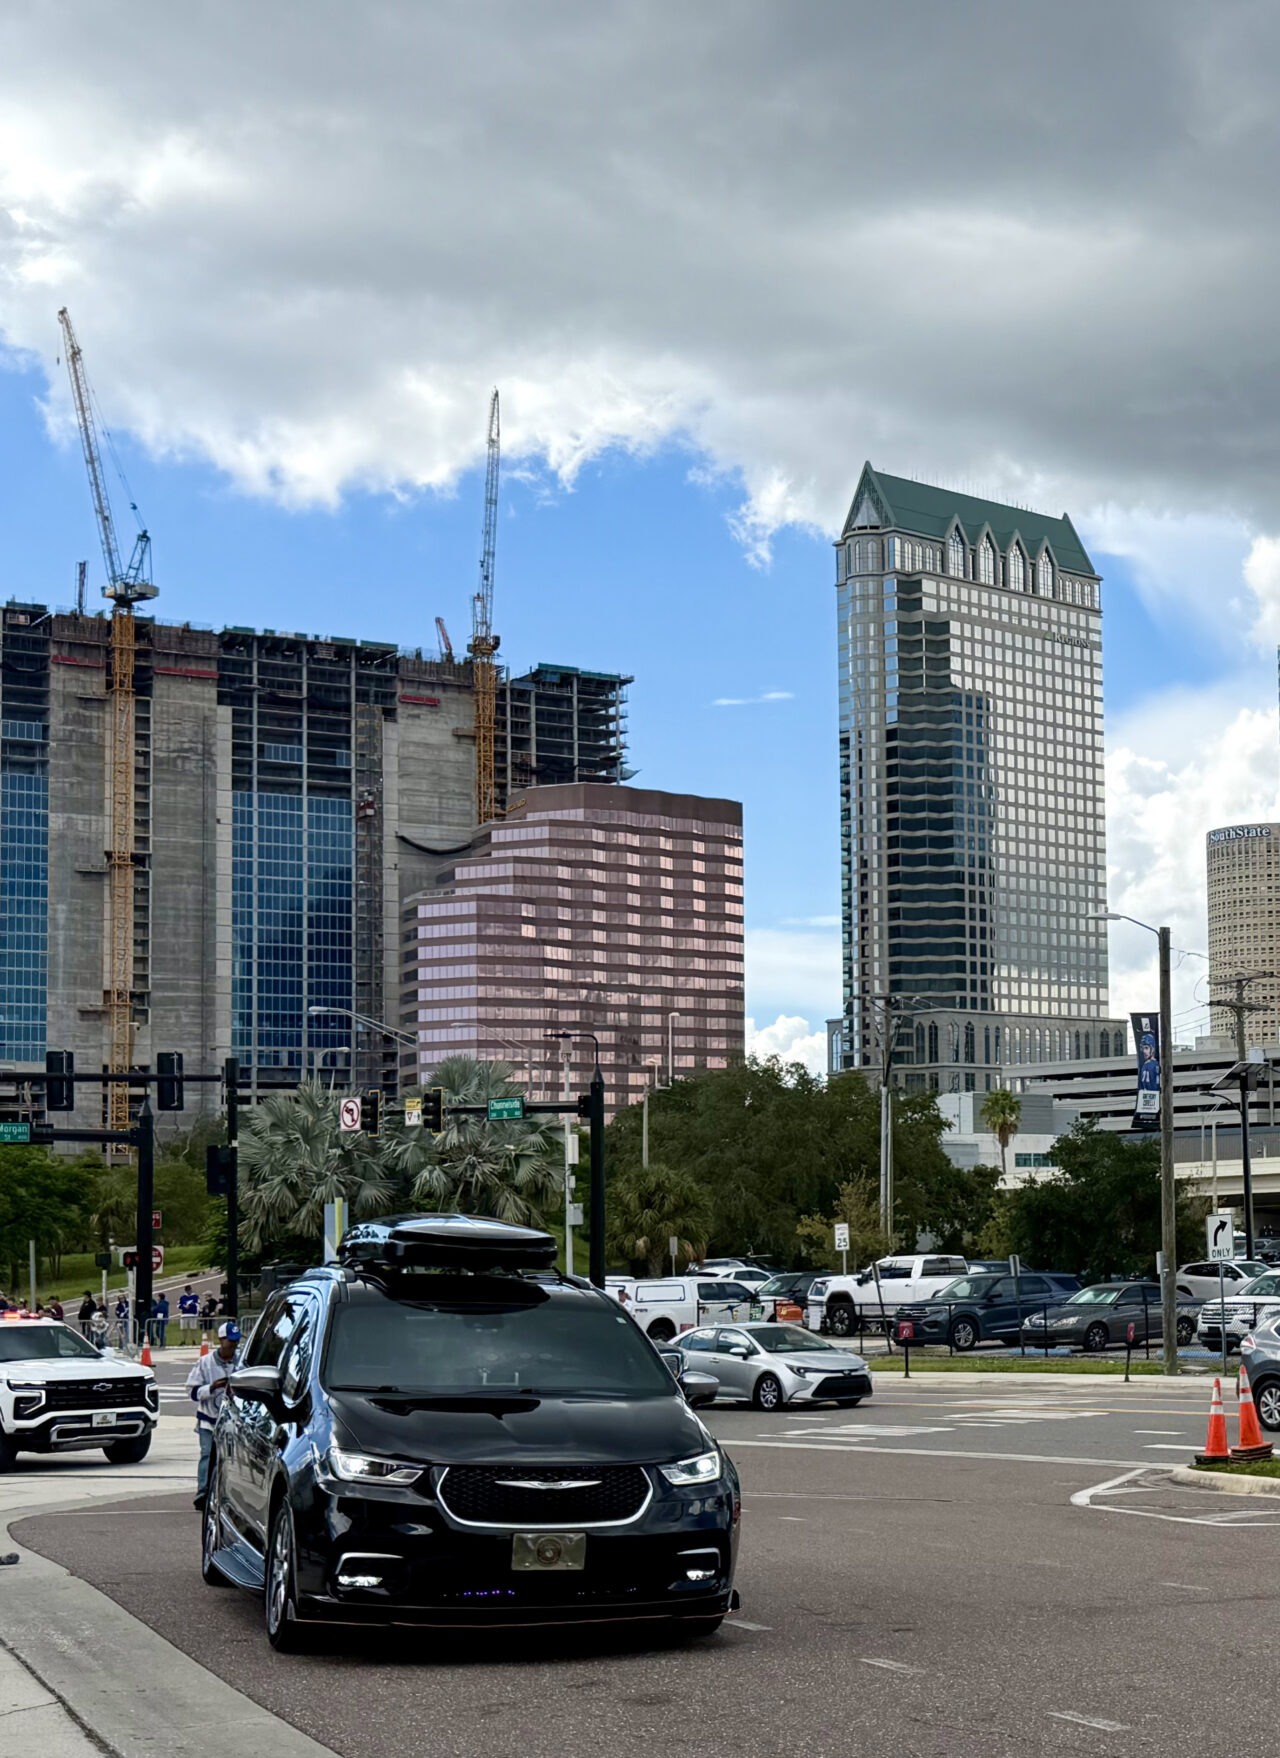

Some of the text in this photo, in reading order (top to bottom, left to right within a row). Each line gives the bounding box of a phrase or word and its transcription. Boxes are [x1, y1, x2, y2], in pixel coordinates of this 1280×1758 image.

[1210, 826, 1271, 843] SouthState
[837, 1237, 848, 1248] 25
[1211, 1247, 1231, 1258] ONLY
